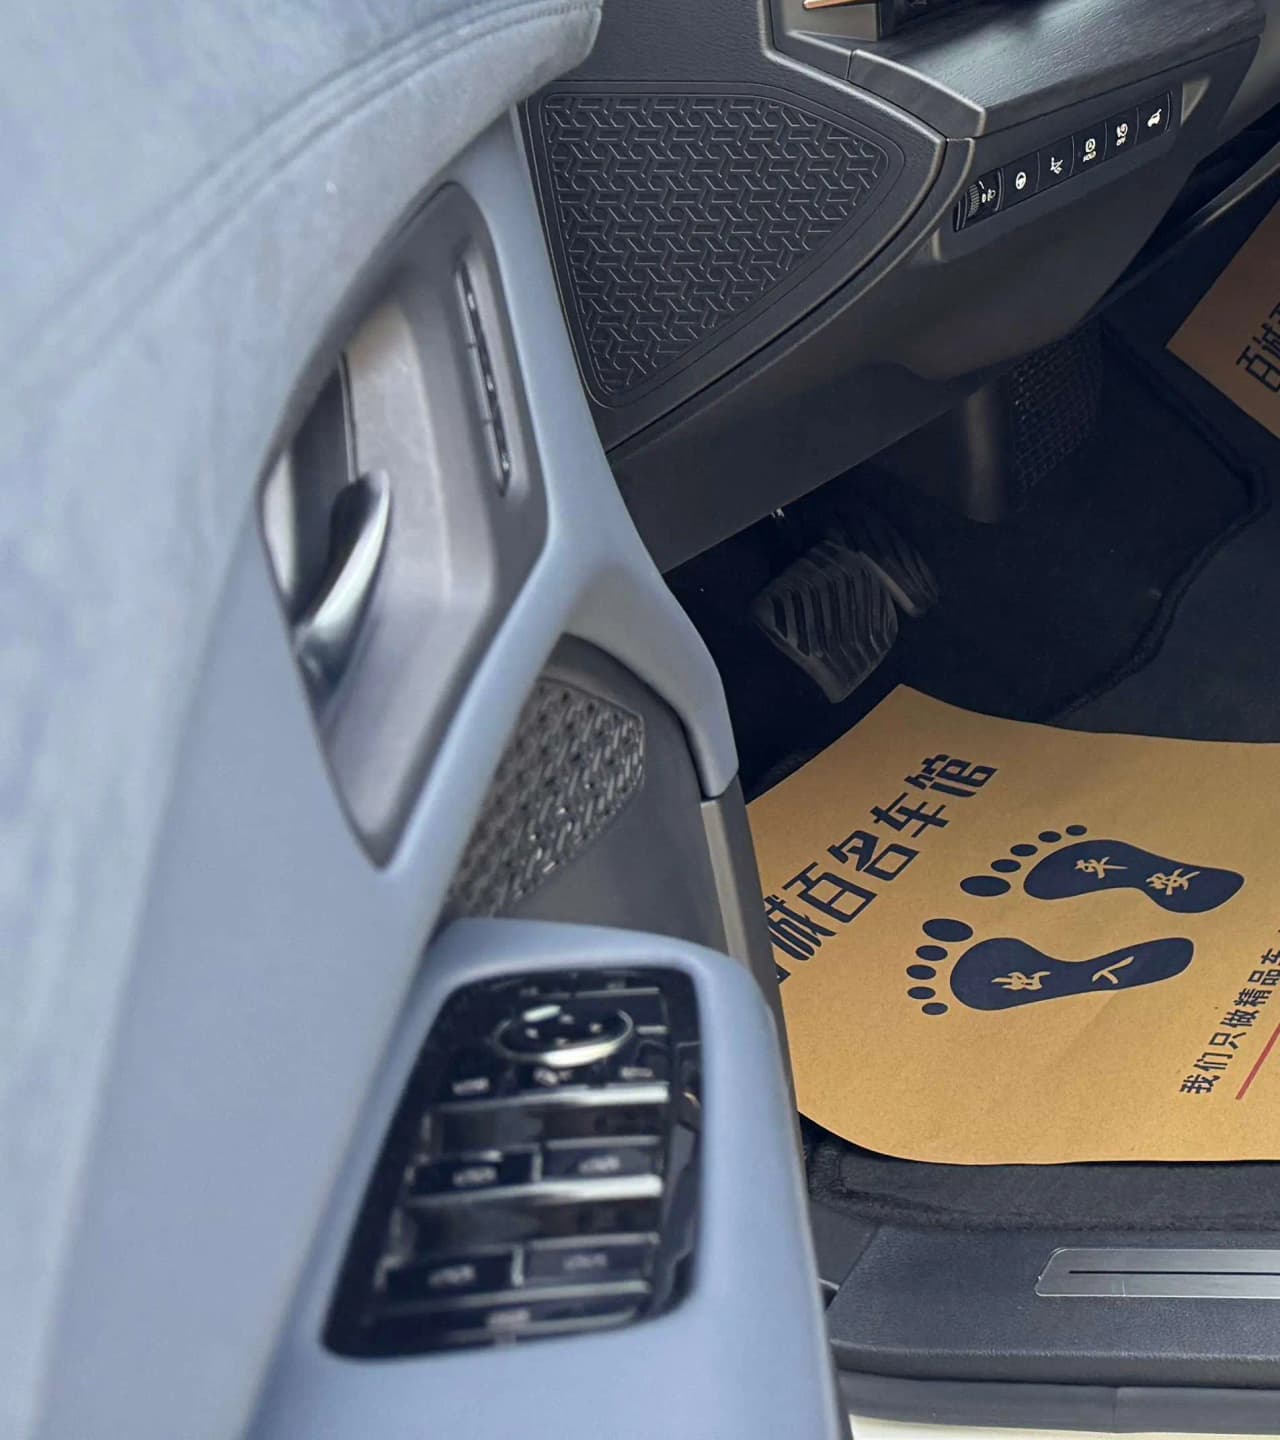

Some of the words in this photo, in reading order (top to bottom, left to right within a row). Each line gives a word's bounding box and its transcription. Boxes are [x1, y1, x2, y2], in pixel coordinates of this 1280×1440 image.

[764, 754, 998, 985] 诚百名车馆
